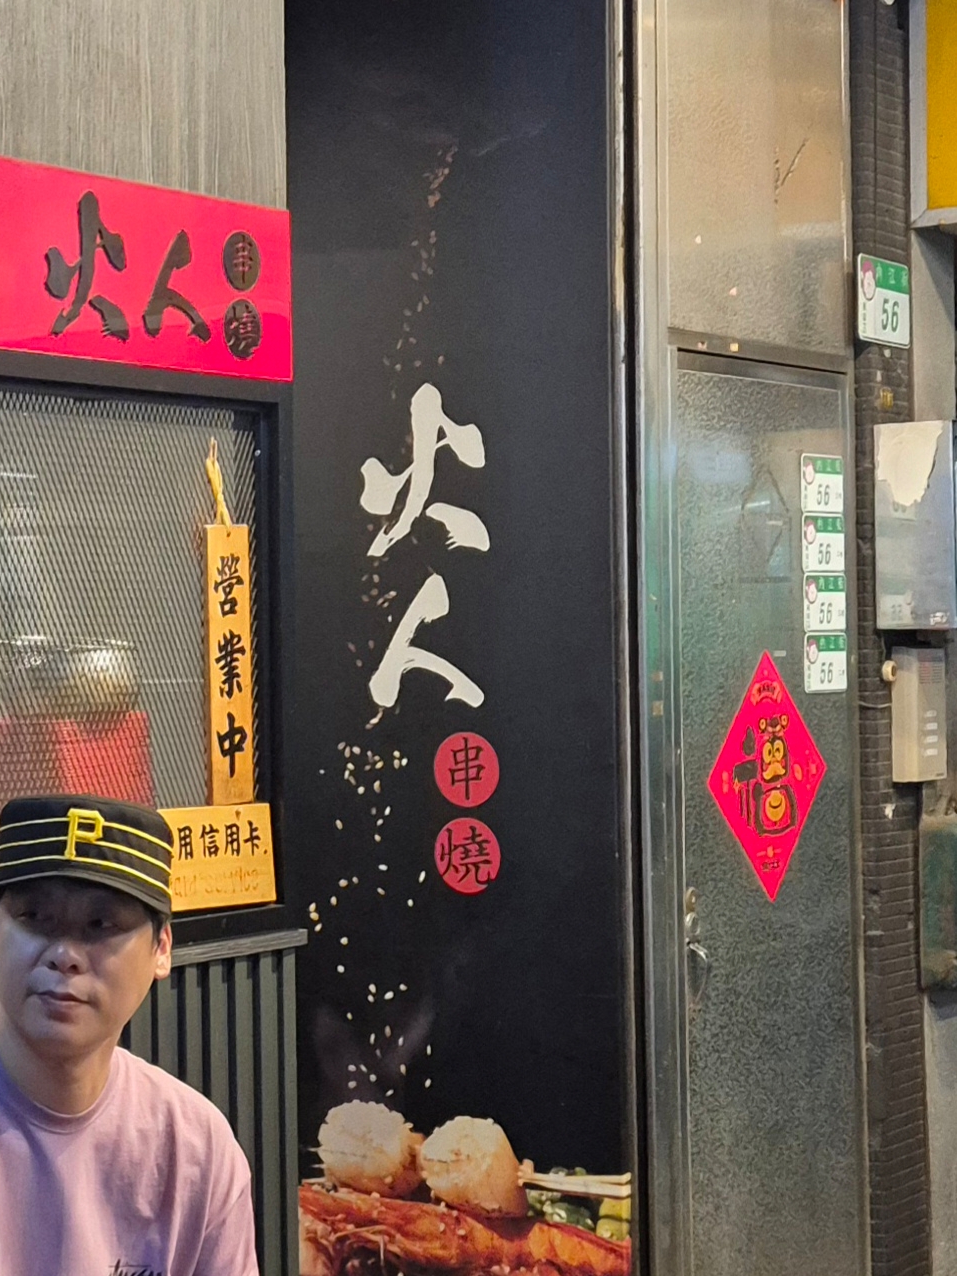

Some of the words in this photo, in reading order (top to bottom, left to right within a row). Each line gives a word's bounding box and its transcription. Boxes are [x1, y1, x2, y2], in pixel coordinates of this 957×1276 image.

[44, 189, 211, 343] 火人
[224, 232, 260, 359] 串燒
[881, 297, 900, 333] 56
[816, 483, 831, 506] 56
[359, 382, 491, 708] 火人
[817, 542, 832, 565] 56
[819, 602, 833, 625] 56
[213, 552, 248, 779] 營業中
[819, 661, 834, 684] 56
[64, 807, 105, 860] P
[439, 736, 494, 890] 串燒
